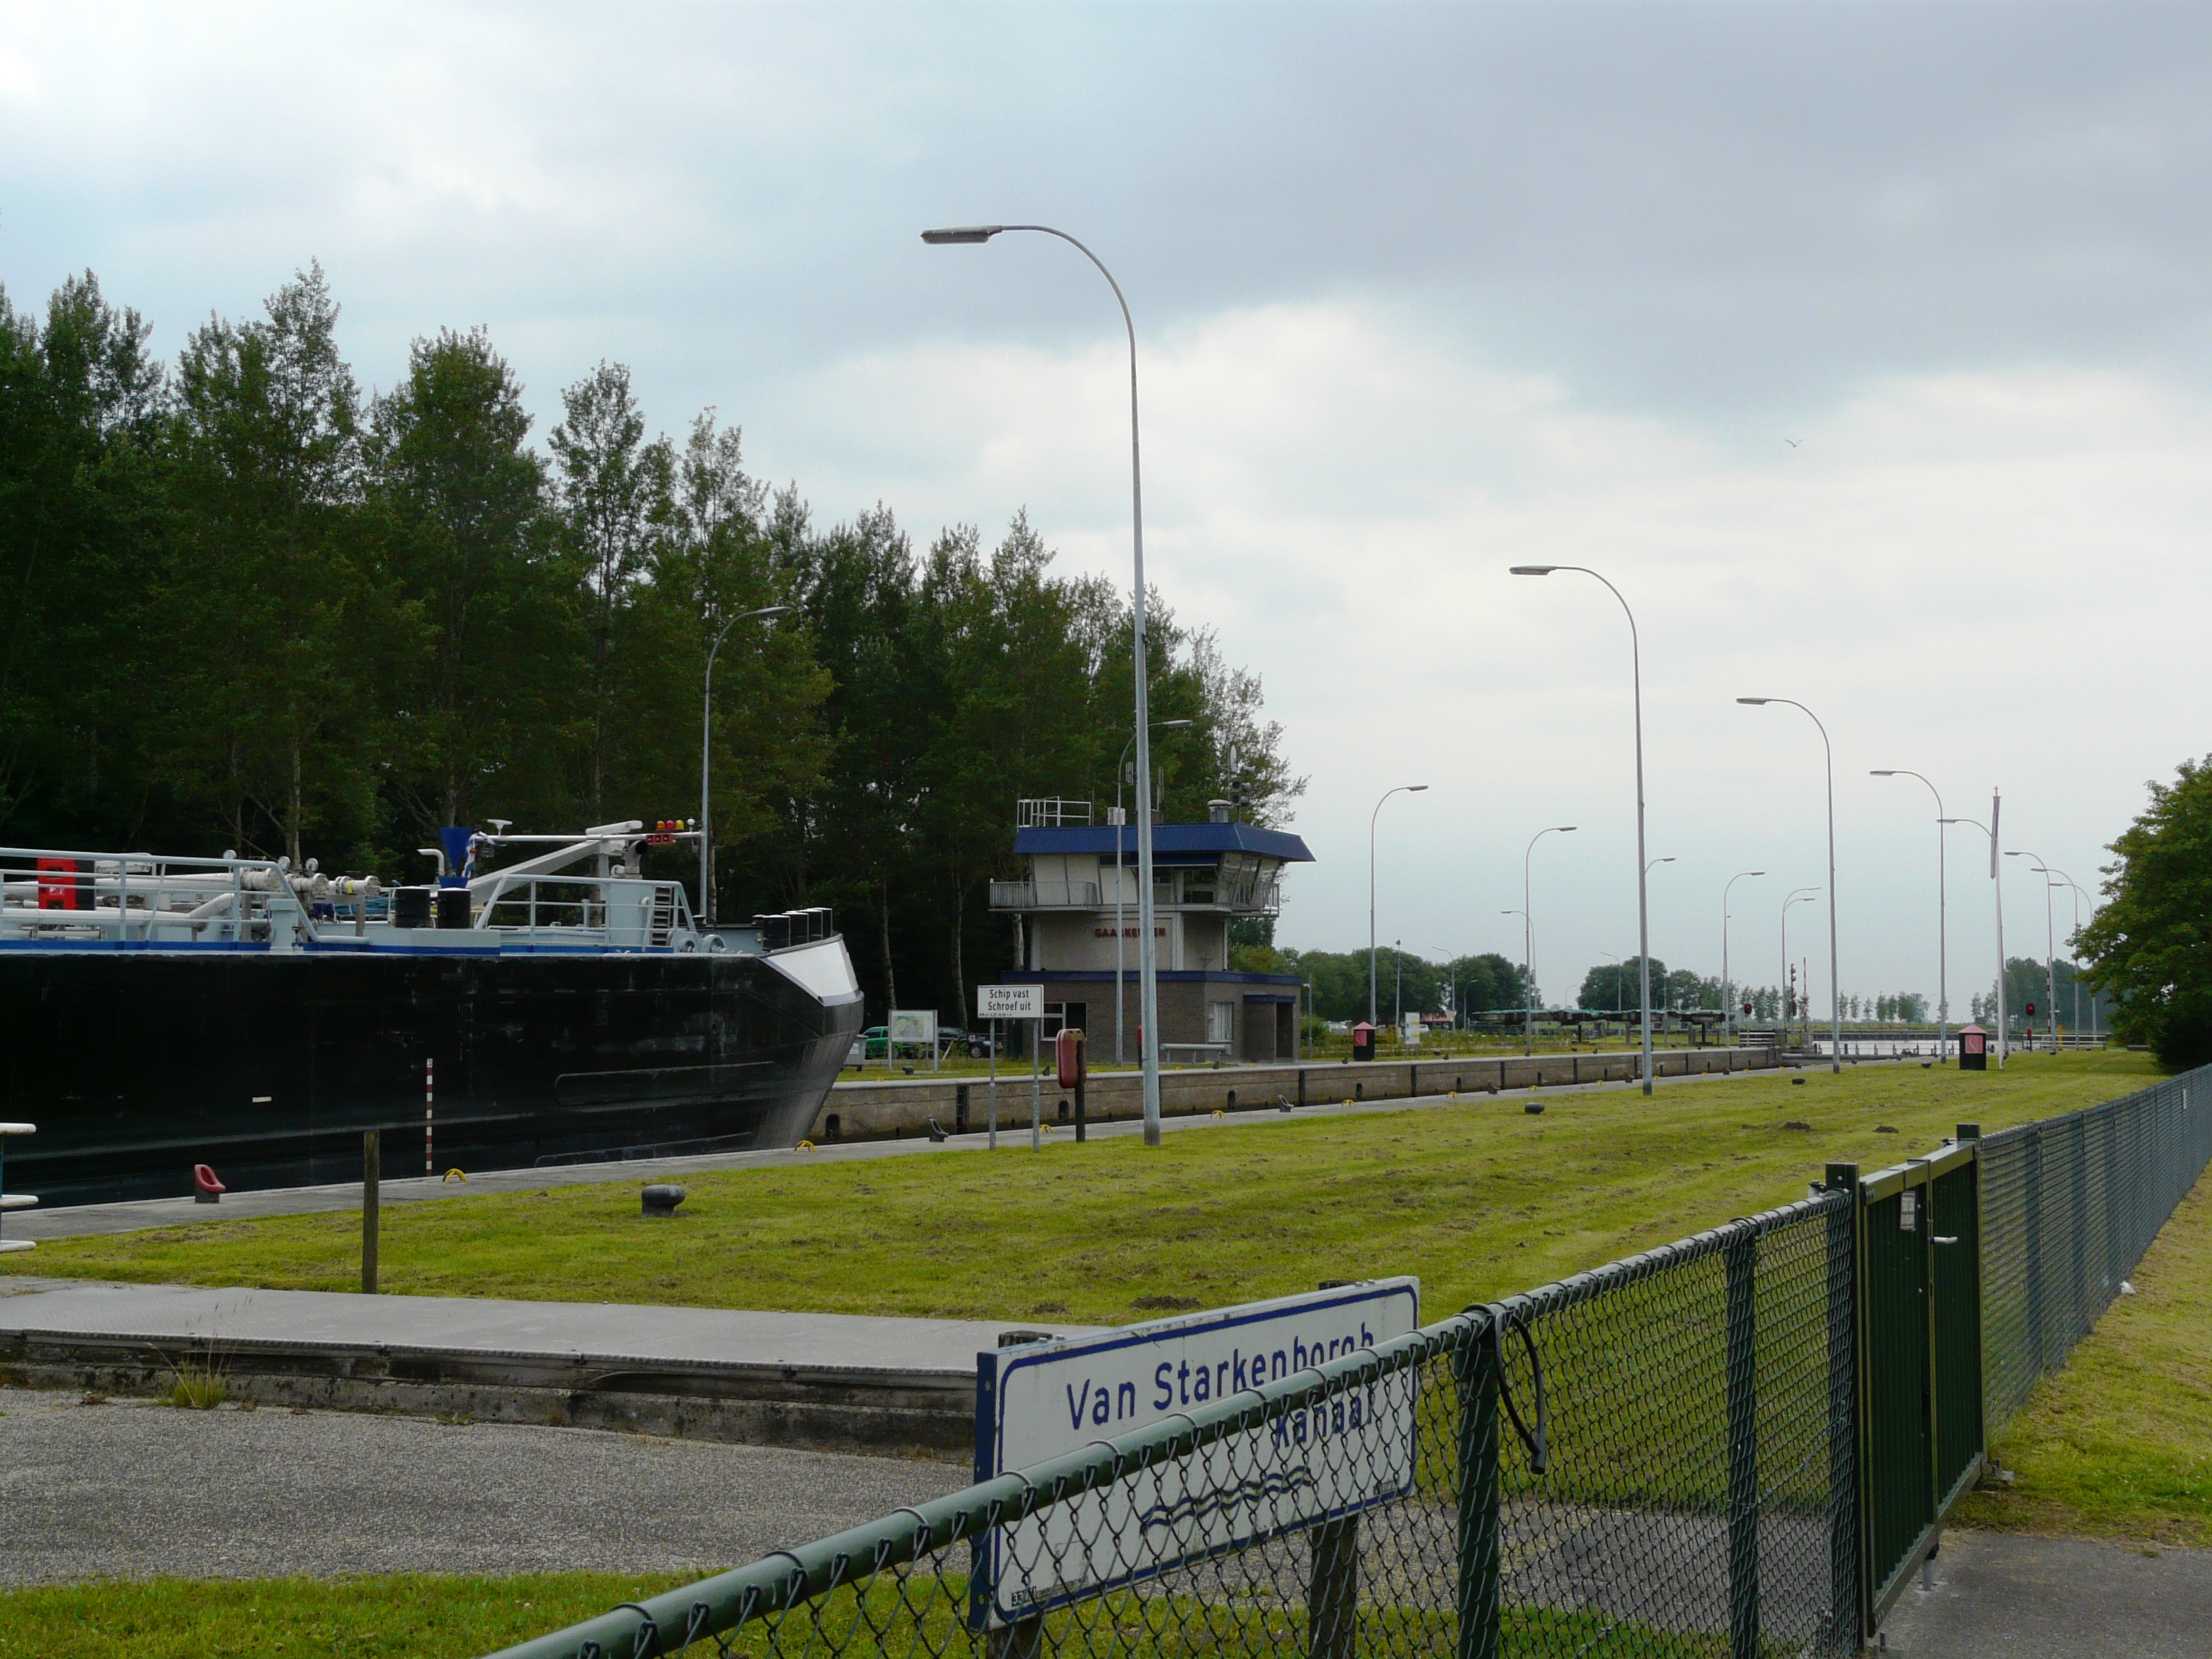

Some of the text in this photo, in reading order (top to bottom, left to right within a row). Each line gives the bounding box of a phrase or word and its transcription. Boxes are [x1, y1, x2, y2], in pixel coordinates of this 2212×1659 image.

[989, 989, 1029, 1000] Schip vast
[987, 1001, 1031, 1010] Schroef uit
[1066, 1378, 1136, 1429] Van
